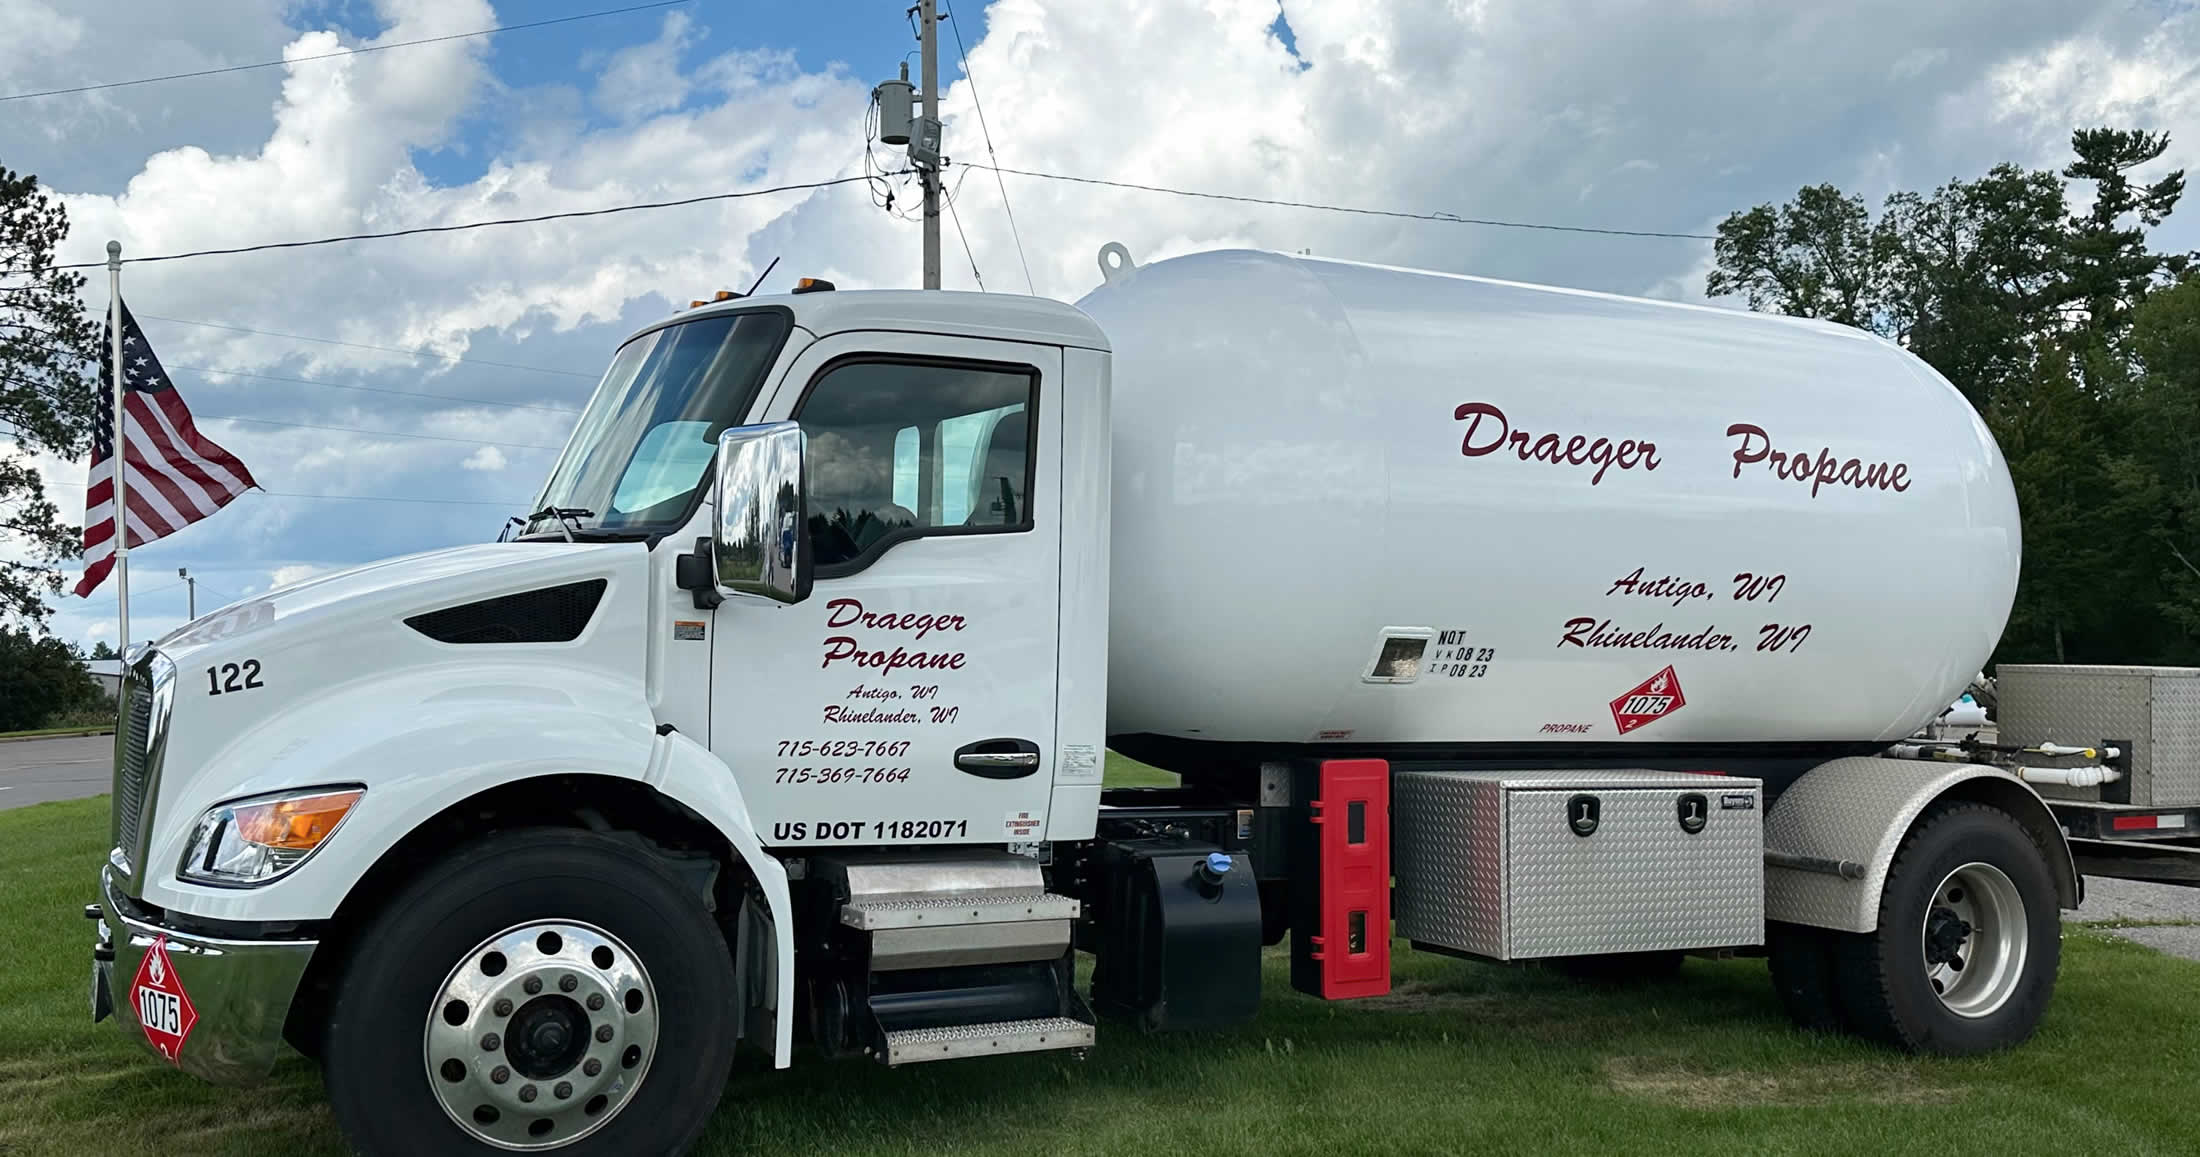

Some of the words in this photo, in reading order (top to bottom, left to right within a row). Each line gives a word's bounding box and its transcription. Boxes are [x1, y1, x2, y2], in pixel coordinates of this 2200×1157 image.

[1454, 402, 1661, 486] Draeger
[1726, 423, 1912, 499] Propane
[1606, 567, 1714, 608] Antigo,
[1732, 572, 1786, 603] WI
[825, 598, 967, 640] Draeger
[1556, 617, 1738, 652] Rhinelander,
[1756, 623, 1812, 654] WI
[822, 636, 966, 676] Propane
[207, 659, 264, 696] 122
[846, 684, 902, 703] Antigo,
[910, 684, 939, 700] WI
[823, 705, 922, 724] Rhinelander,
[929, 705, 960, 724] WI
[1623, 696, 1671, 714] 1075
[1539, 723, 1593, 733] PROPANE
[1624, 719, 1638, 728] 2
[777, 740, 911, 758] 715-623-7667
[775, 767, 911, 784] 715-369-7664
[773, 822, 808, 841] US
[815, 821, 866, 840] DOT
[874, 820, 969, 839] 1182071
[140, 988, 179, 1035] 1075
